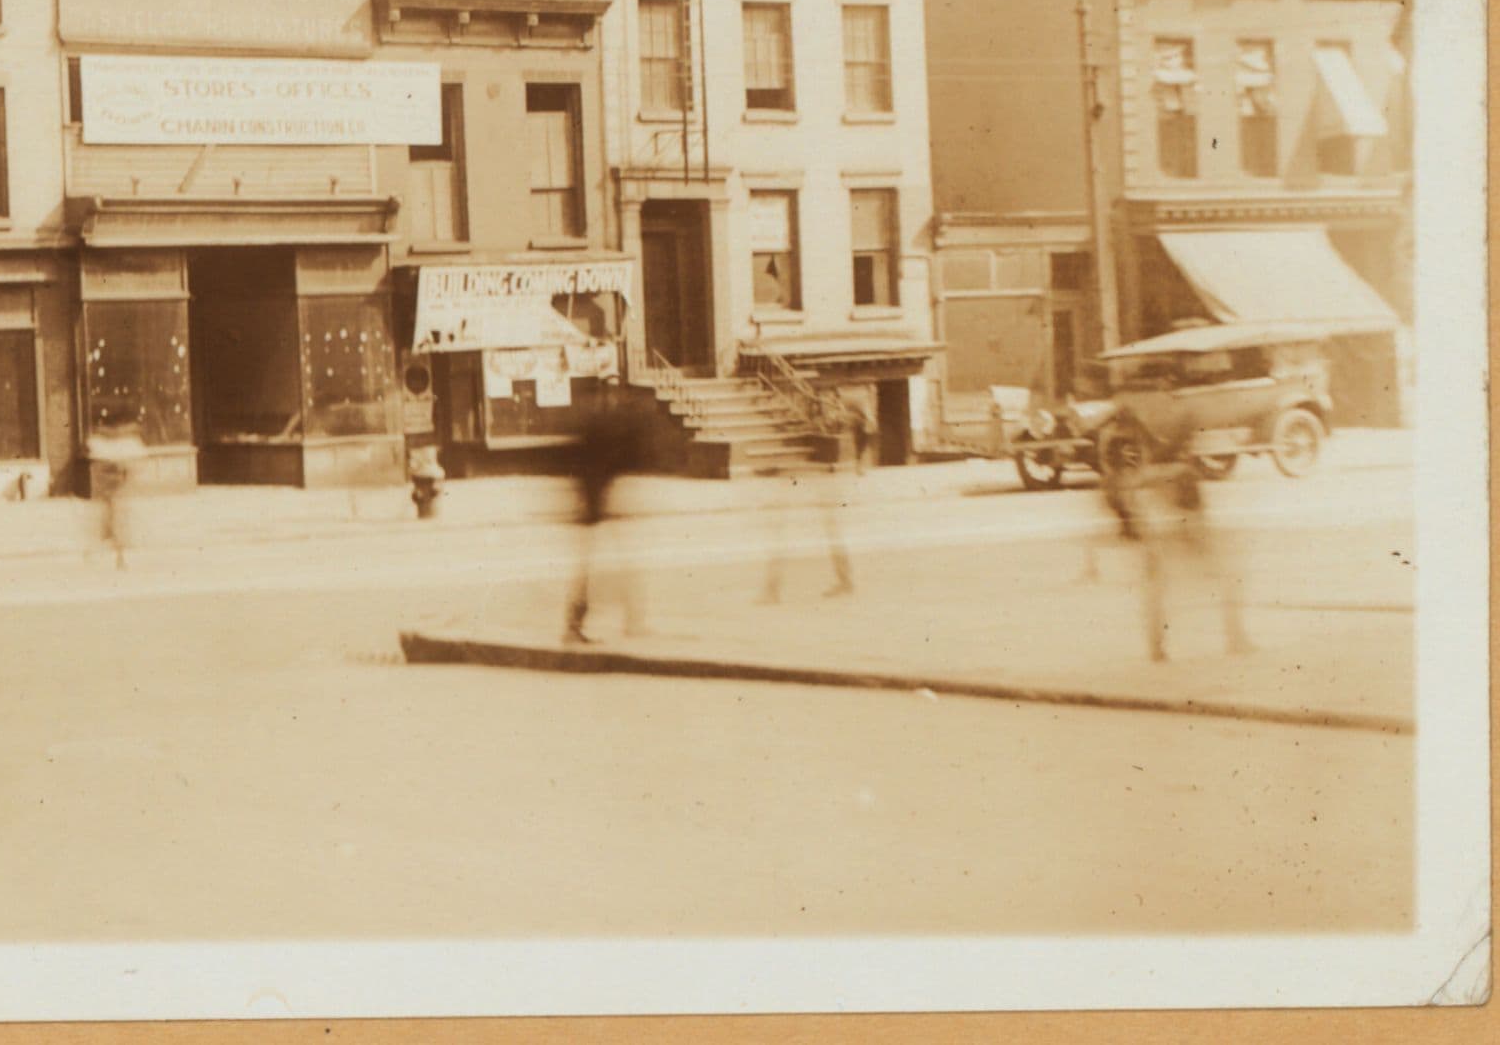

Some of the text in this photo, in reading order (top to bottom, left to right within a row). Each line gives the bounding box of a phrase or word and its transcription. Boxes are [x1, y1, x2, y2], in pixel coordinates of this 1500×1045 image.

[163, 78, 256, 99] STORES
[275, 78, 373, 99] OFFICES
[160, 118, 236, 136] CHANIN
[427, 267, 626, 298] BUILDING COMING DOWN
